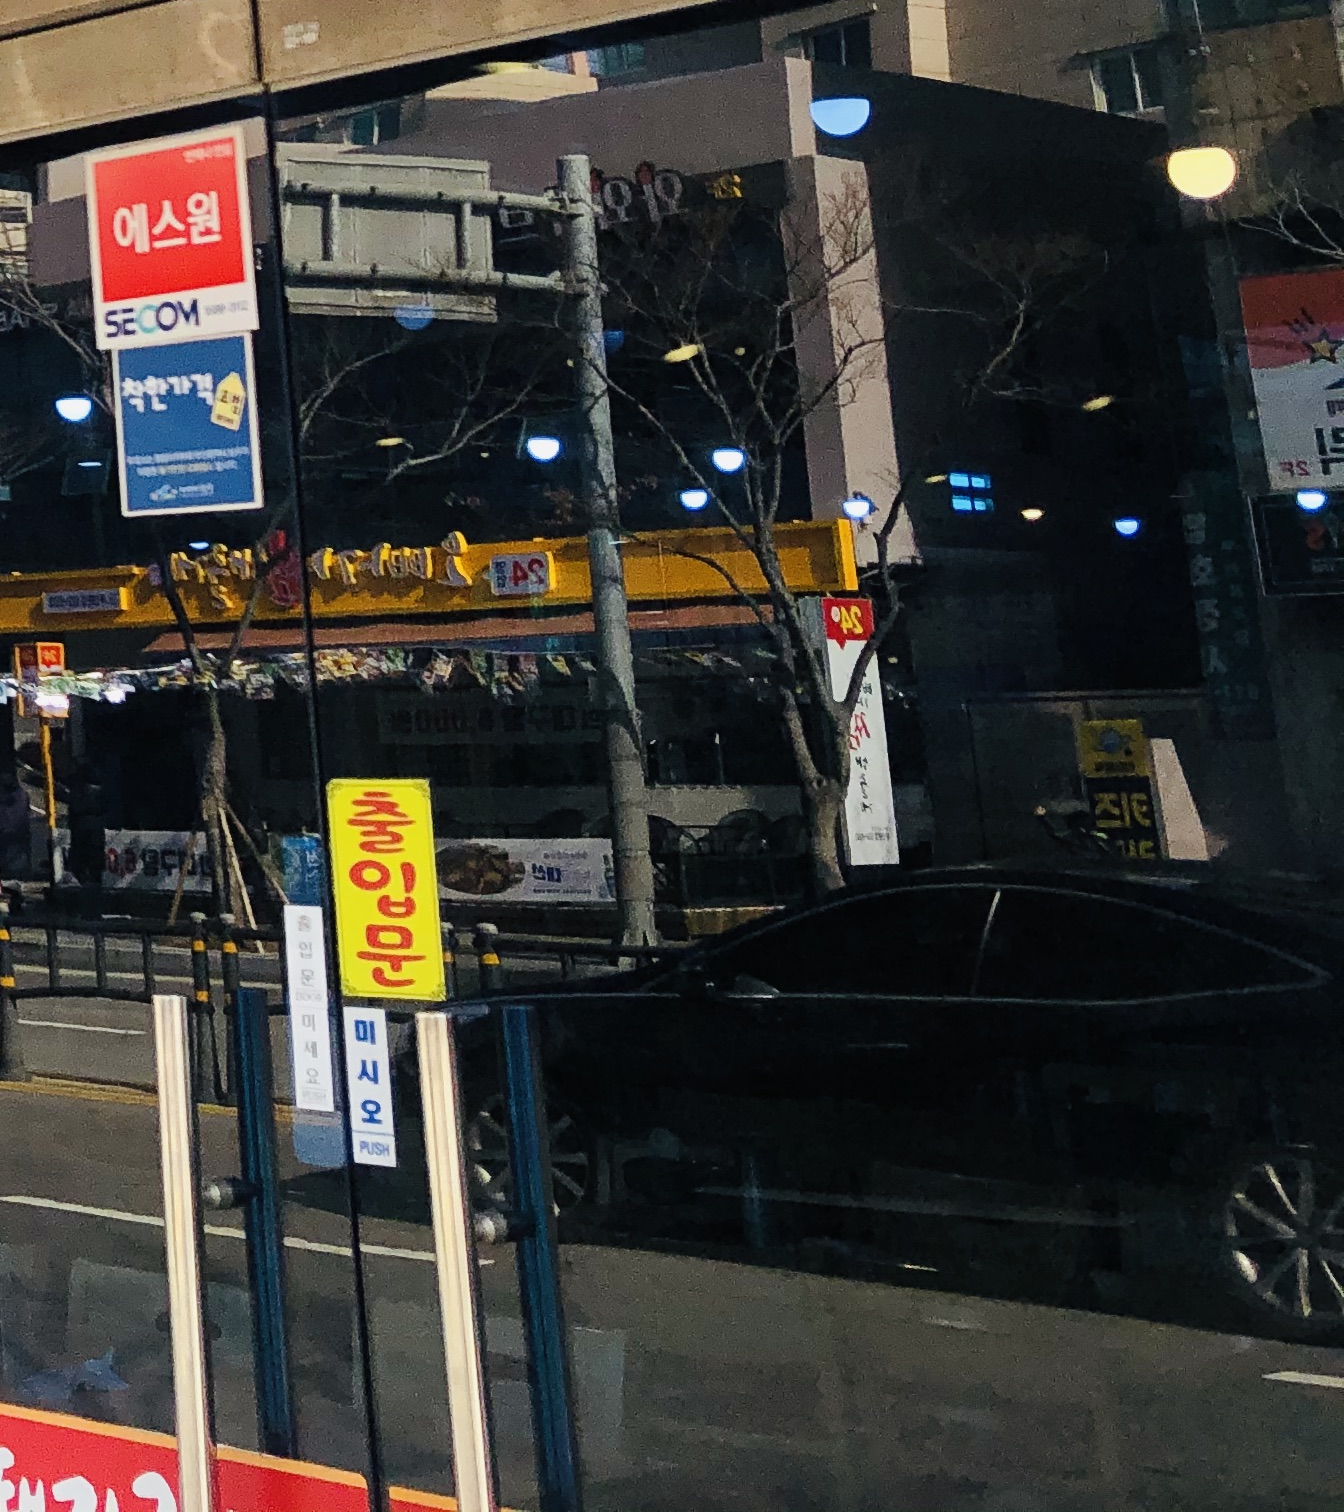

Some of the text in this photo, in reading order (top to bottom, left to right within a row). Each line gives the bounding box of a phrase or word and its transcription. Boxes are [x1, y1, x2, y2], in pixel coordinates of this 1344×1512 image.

[112, 191, 224, 254] 에스원
[104, 298, 200, 338] SECOM
[347, 791, 427, 988] 출입문
[353, 1018, 385, 1126] 미시오
[359, 1140, 390, 1159] PUSH
